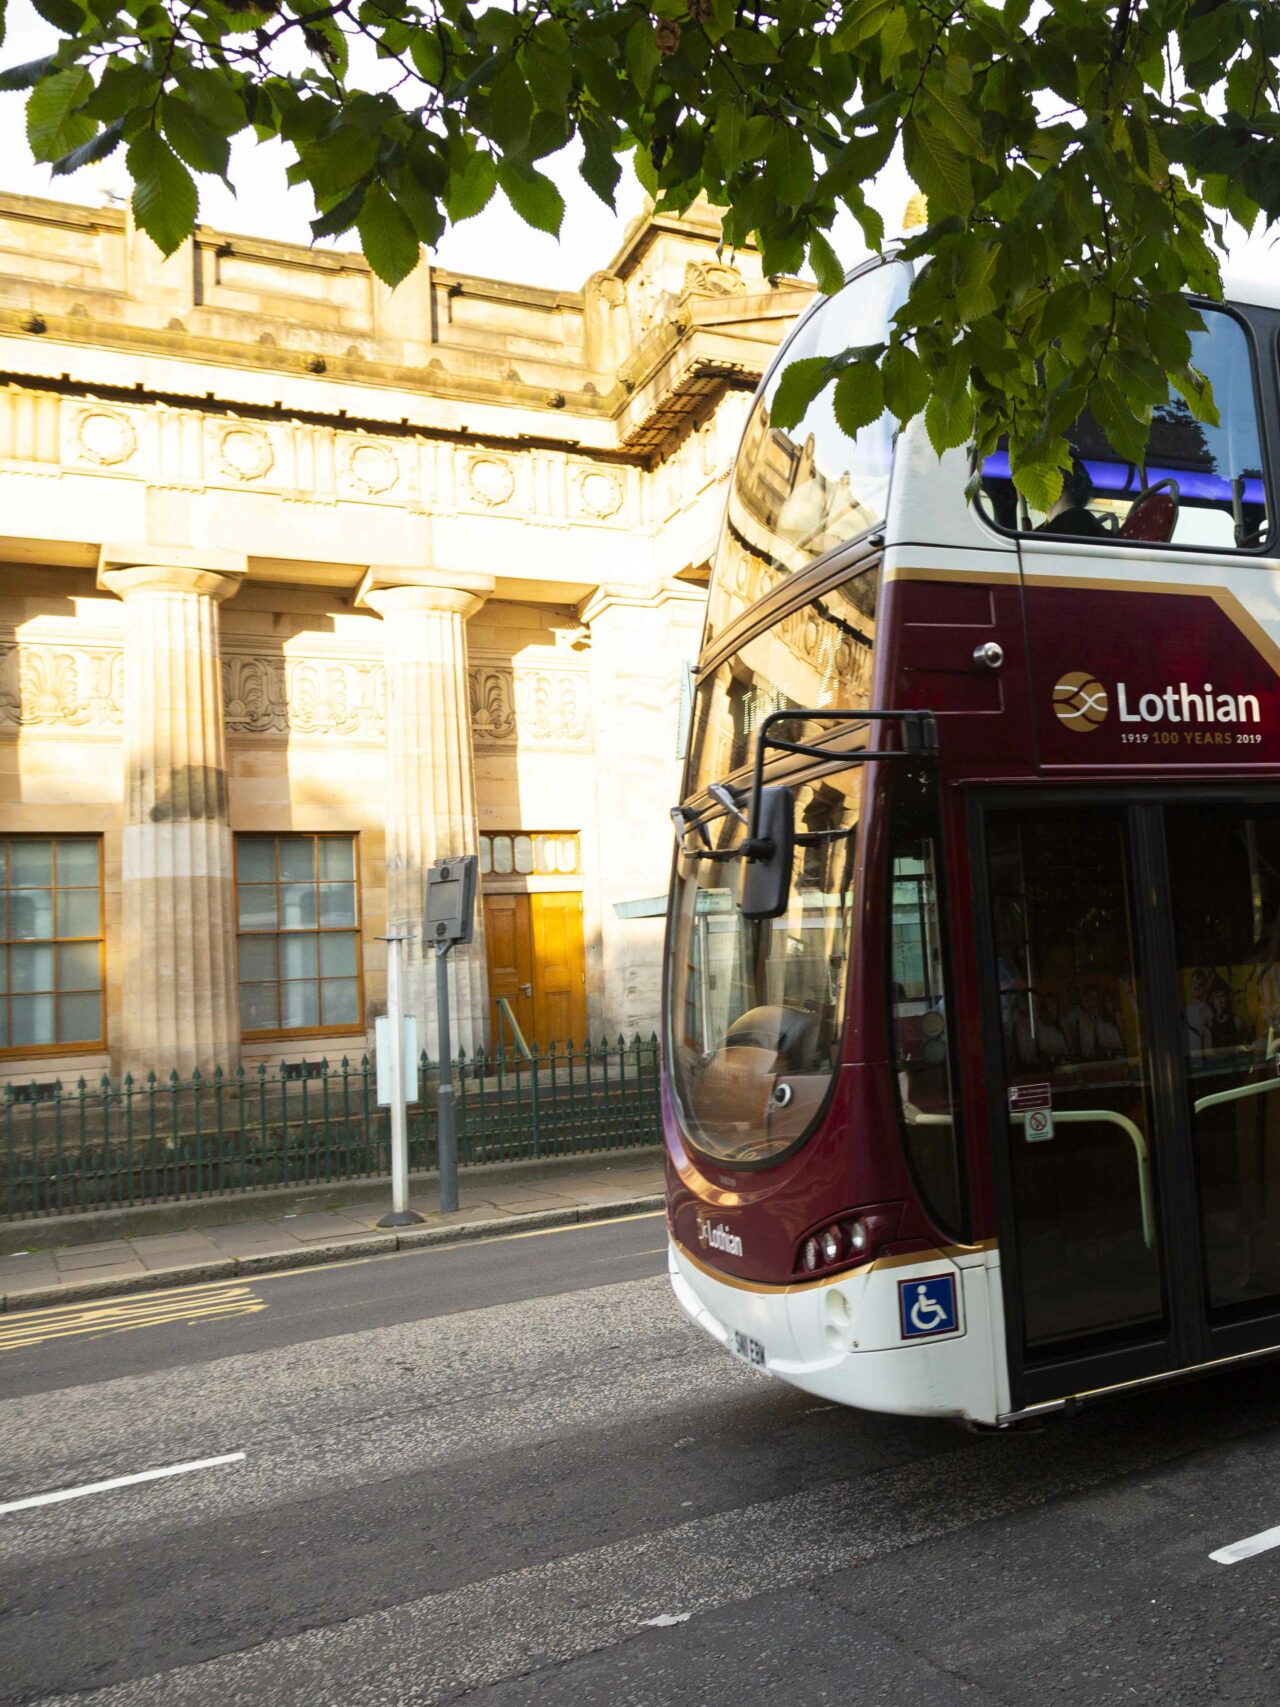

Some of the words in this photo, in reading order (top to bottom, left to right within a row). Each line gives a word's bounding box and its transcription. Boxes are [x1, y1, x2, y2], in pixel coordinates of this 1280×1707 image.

[1117, 683, 1261, 723] Lothian
[1121, 733, 1149, 744] 1919
[1153, 732, 1179, 744] 100
[1184, 732, 1232, 744] YEARS
[1236, 734, 1262, 744] 2019
